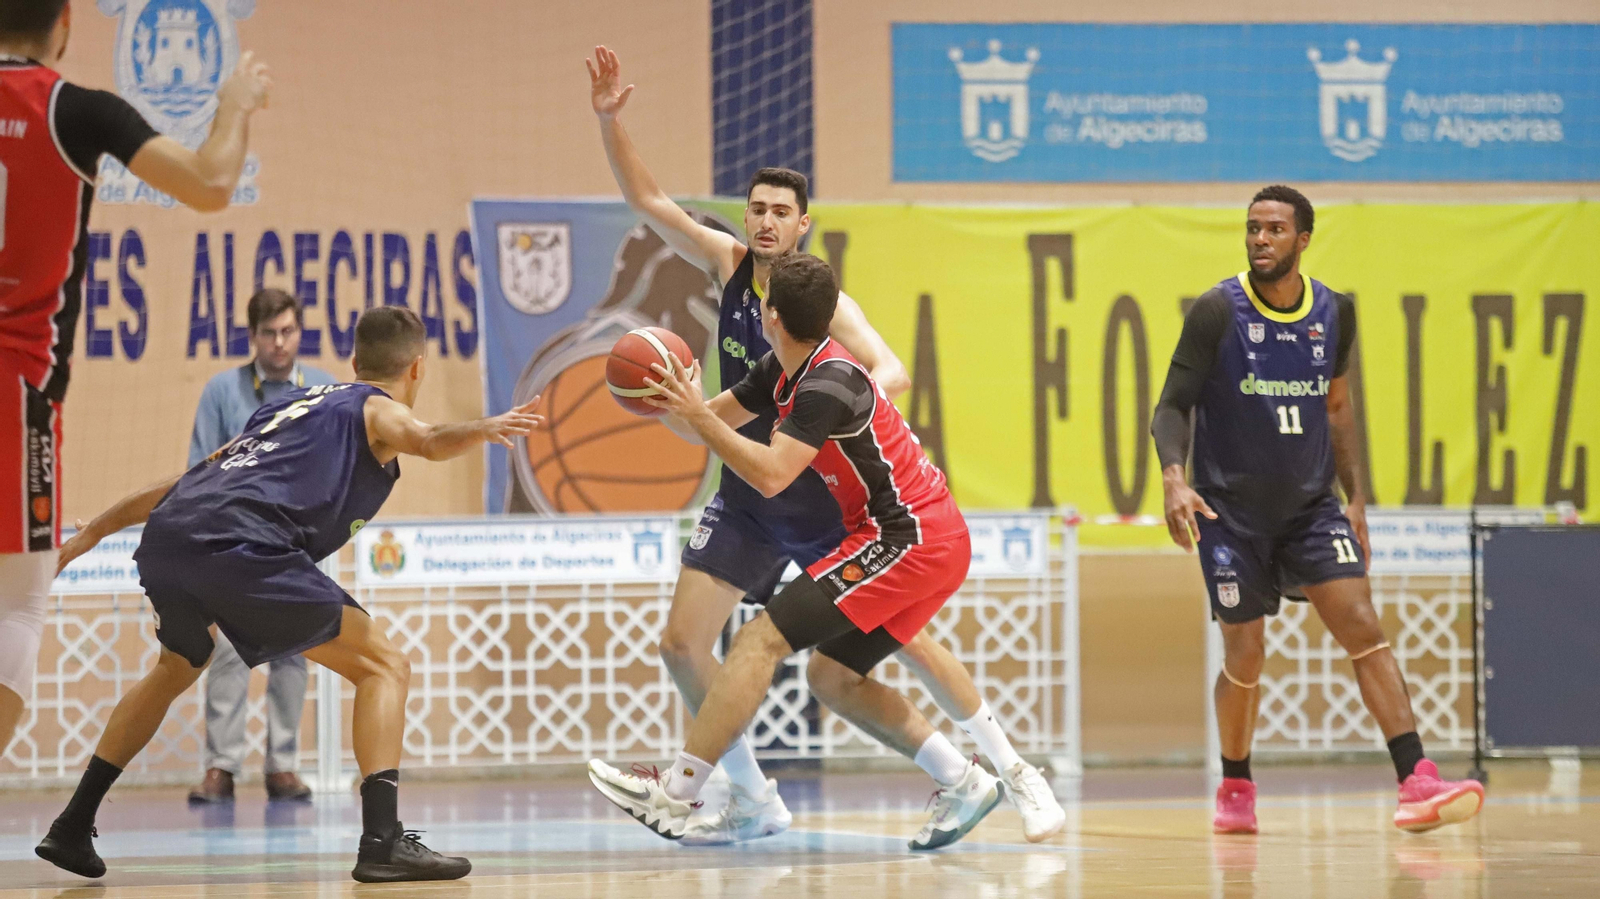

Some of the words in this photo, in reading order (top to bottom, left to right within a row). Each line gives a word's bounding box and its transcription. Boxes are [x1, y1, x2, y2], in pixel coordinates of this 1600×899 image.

[1044, 92, 1208, 119] Ayuntamiento
[1402, 90, 1564, 119] Ayuntamiento
[1077, 116, 1208, 149] Algeciras
[1433, 115, 1564, 148] Algeciras
[1276, 405, 1304, 434] 11
[414, 530, 526, 548] Ayuntamiento
[1332, 537, 1359, 564] 11
